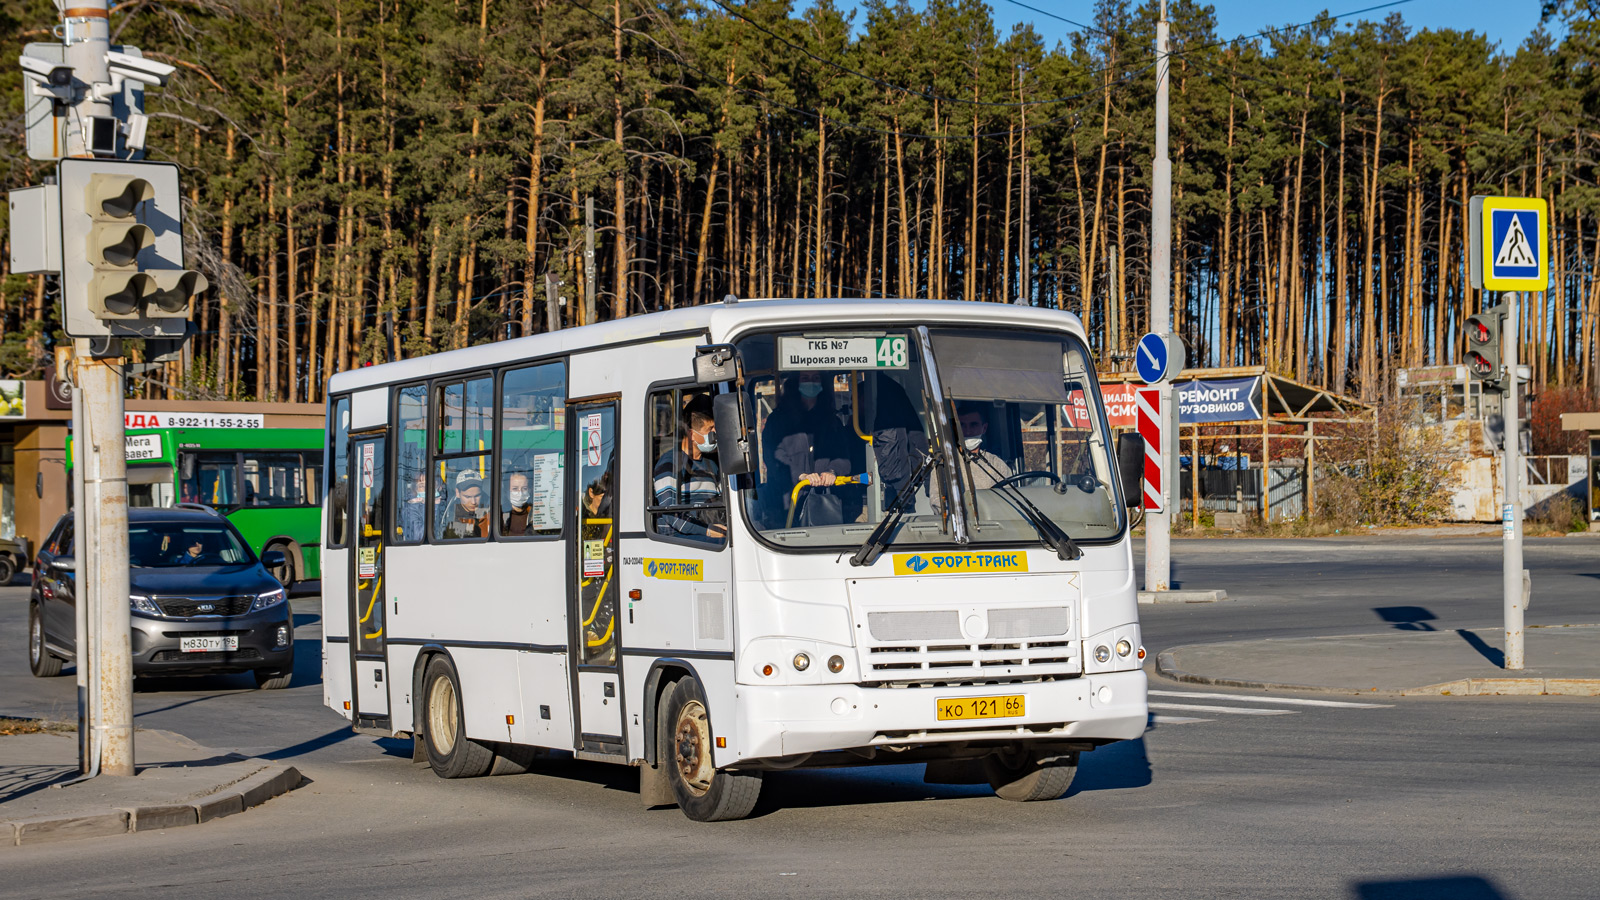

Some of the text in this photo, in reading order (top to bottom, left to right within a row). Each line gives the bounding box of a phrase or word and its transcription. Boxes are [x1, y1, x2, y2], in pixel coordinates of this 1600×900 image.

[808, 340, 849, 350] ГКБ №7
[877, 338, 906, 367] 48
[790, 354, 868, 366] Широкая речка
[1179, 387, 1240, 404] РЕМОНТ
[1179, 401, 1245, 415] РУЗОВИКОВ
[168, 417, 260, 428] 8-922-11-55-2-55
[932, 554, 1018, 569] ФОРТ-ТРАНС
[658, 562, 699, 576] ФОРТ-ТРАНС
[945, 699, 997, 717] КО 121
[1005, 697, 1020, 710] 66
